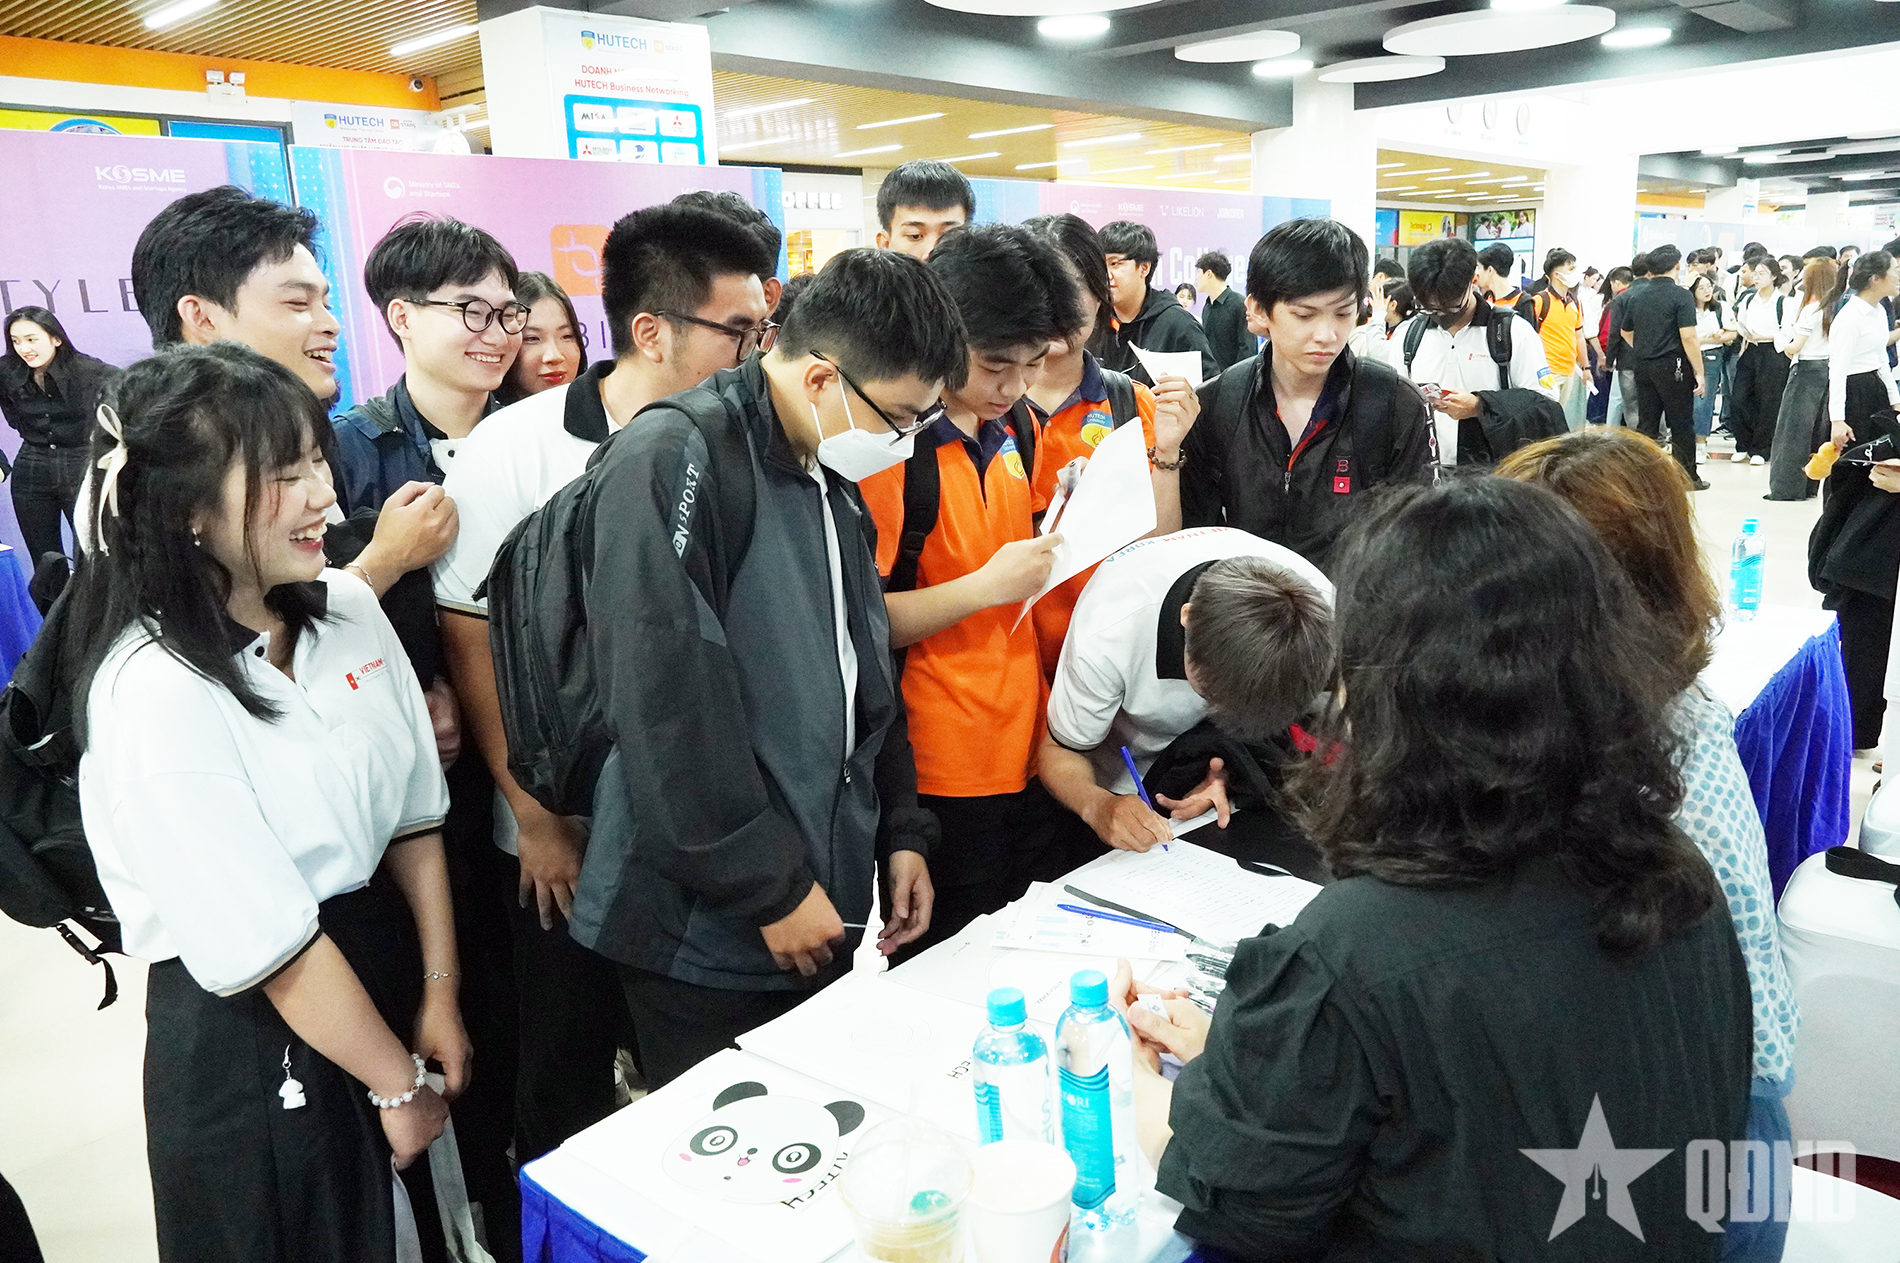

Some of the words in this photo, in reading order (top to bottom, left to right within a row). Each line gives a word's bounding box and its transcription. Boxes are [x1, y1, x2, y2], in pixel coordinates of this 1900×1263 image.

[597, 33, 647, 50] HUTECH
[581, 65, 612, 75] DOANH
[574, 79, 608, 90] HUTECH
[610, 82, 644, 94] Business
[645, 86, 689, 98] Networking
[338, 115, 384, 127] HUTECH
[343, 136, 363, 144] TRUNG
[95, 165, 186, 184] KOSME
[408, 181, 434, 189] Ministry
[423, 190, 451, 198] Startups
[1118, 202, 1144, 213] KOSME
[1171, 206, 1204, 217] LIKELION
